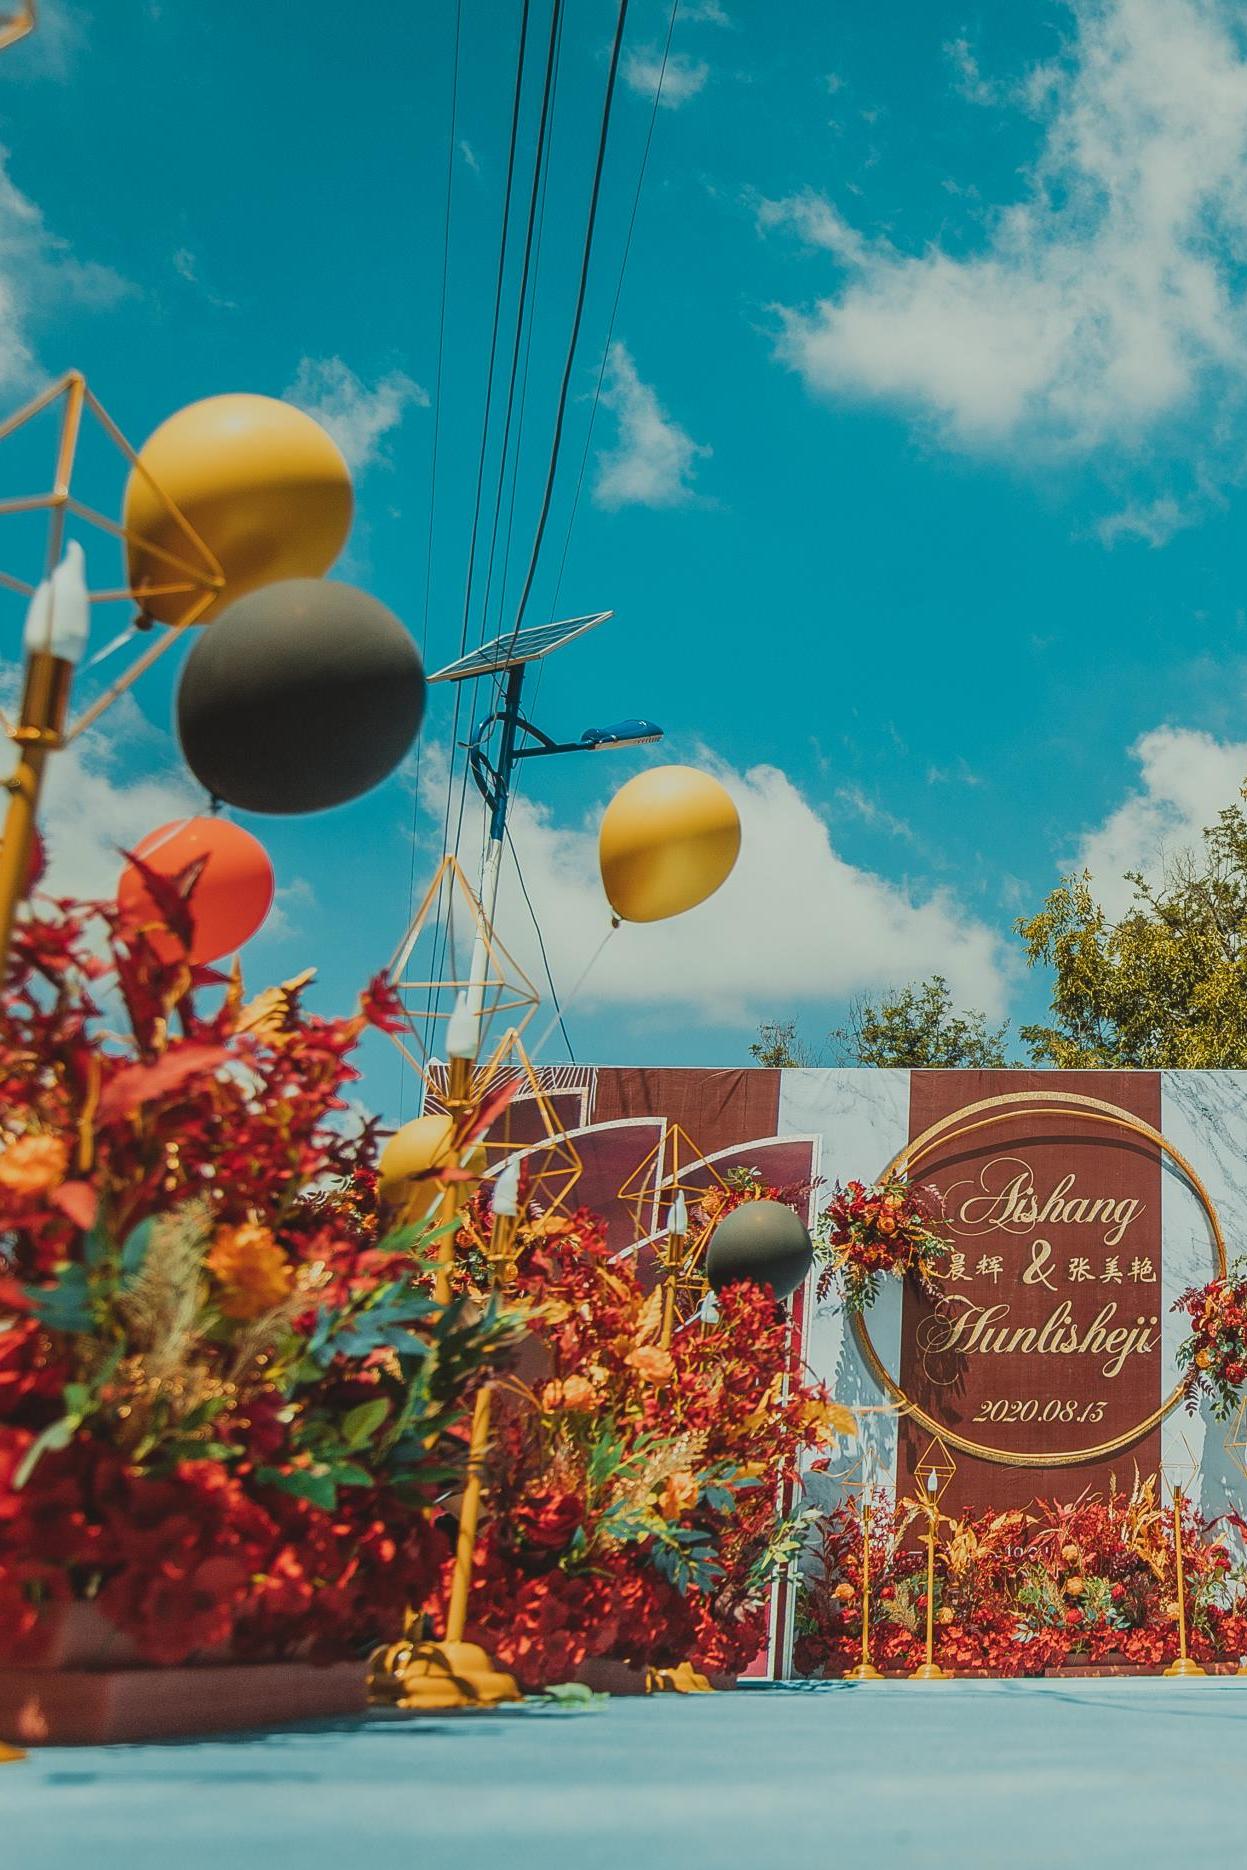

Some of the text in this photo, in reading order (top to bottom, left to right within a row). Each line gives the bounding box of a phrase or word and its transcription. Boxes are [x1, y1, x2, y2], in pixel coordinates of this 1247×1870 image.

[942, 1157, 1146, 1246] Aishang
[1022, 1239, 1058, 1291] &
[1068, 1255, 1157, 1285] 张美艳
[917, 1295, 1161, 1385] Hunlisheji
[973, 1398, 1109, 1423] 2020.08.13
